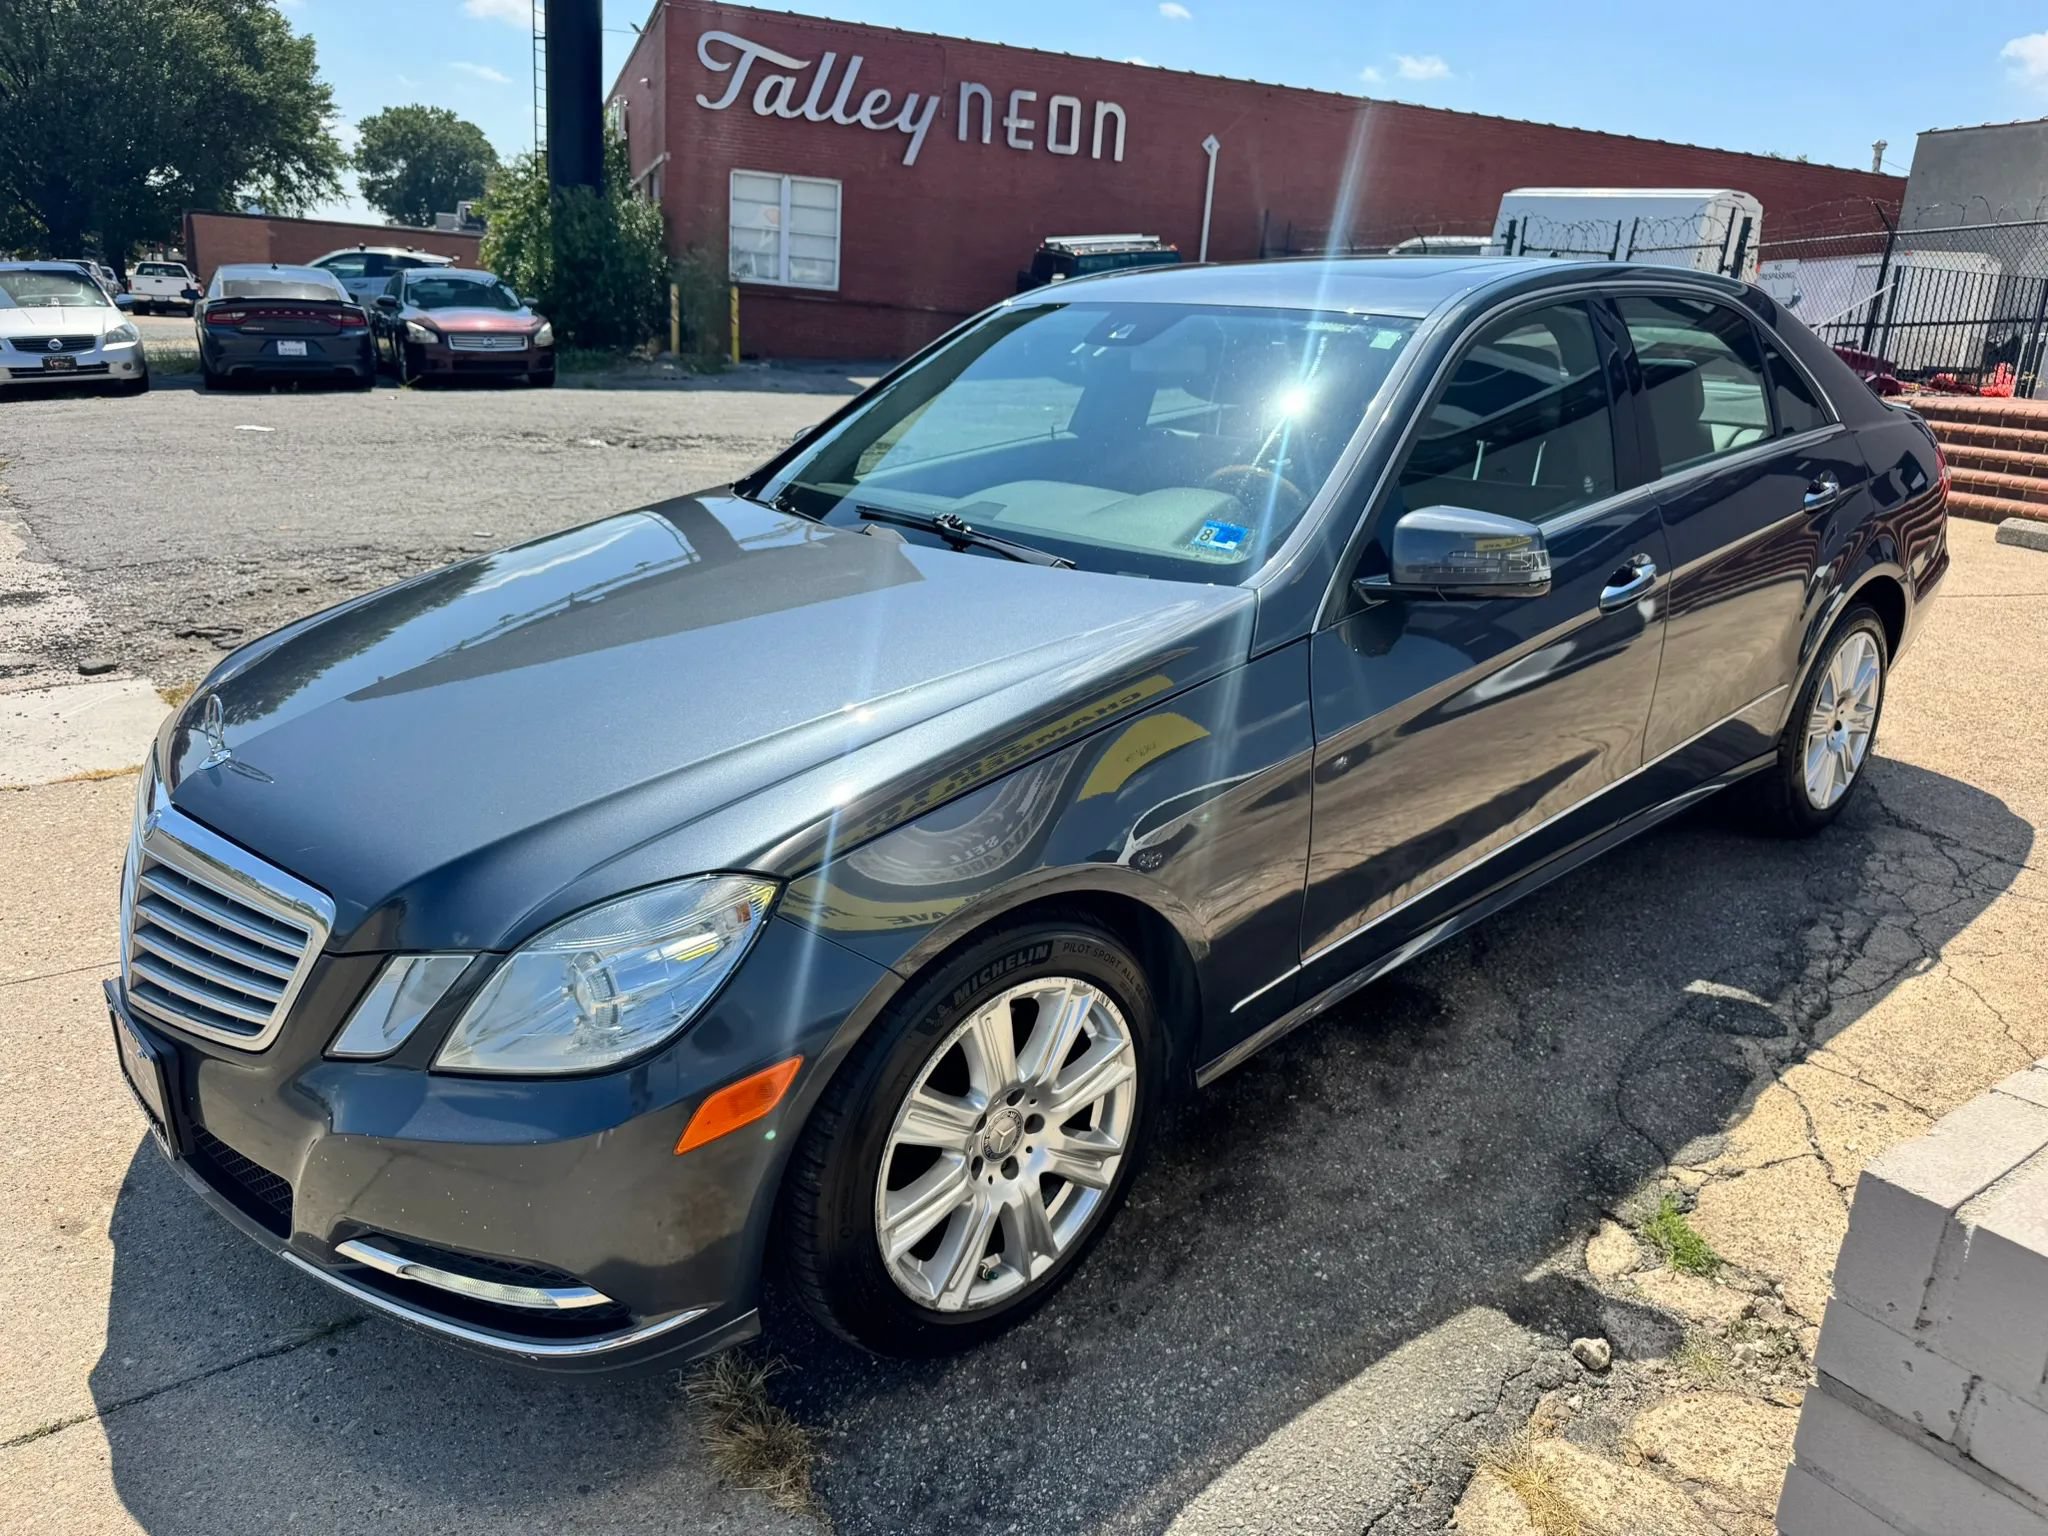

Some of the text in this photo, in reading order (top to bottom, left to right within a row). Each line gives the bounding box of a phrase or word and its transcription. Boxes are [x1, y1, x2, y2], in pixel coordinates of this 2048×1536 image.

[696, 30, 941, 166] Talley
[953, 942, 1136, 1008] MICHELIN PILOT SPORT ALL
